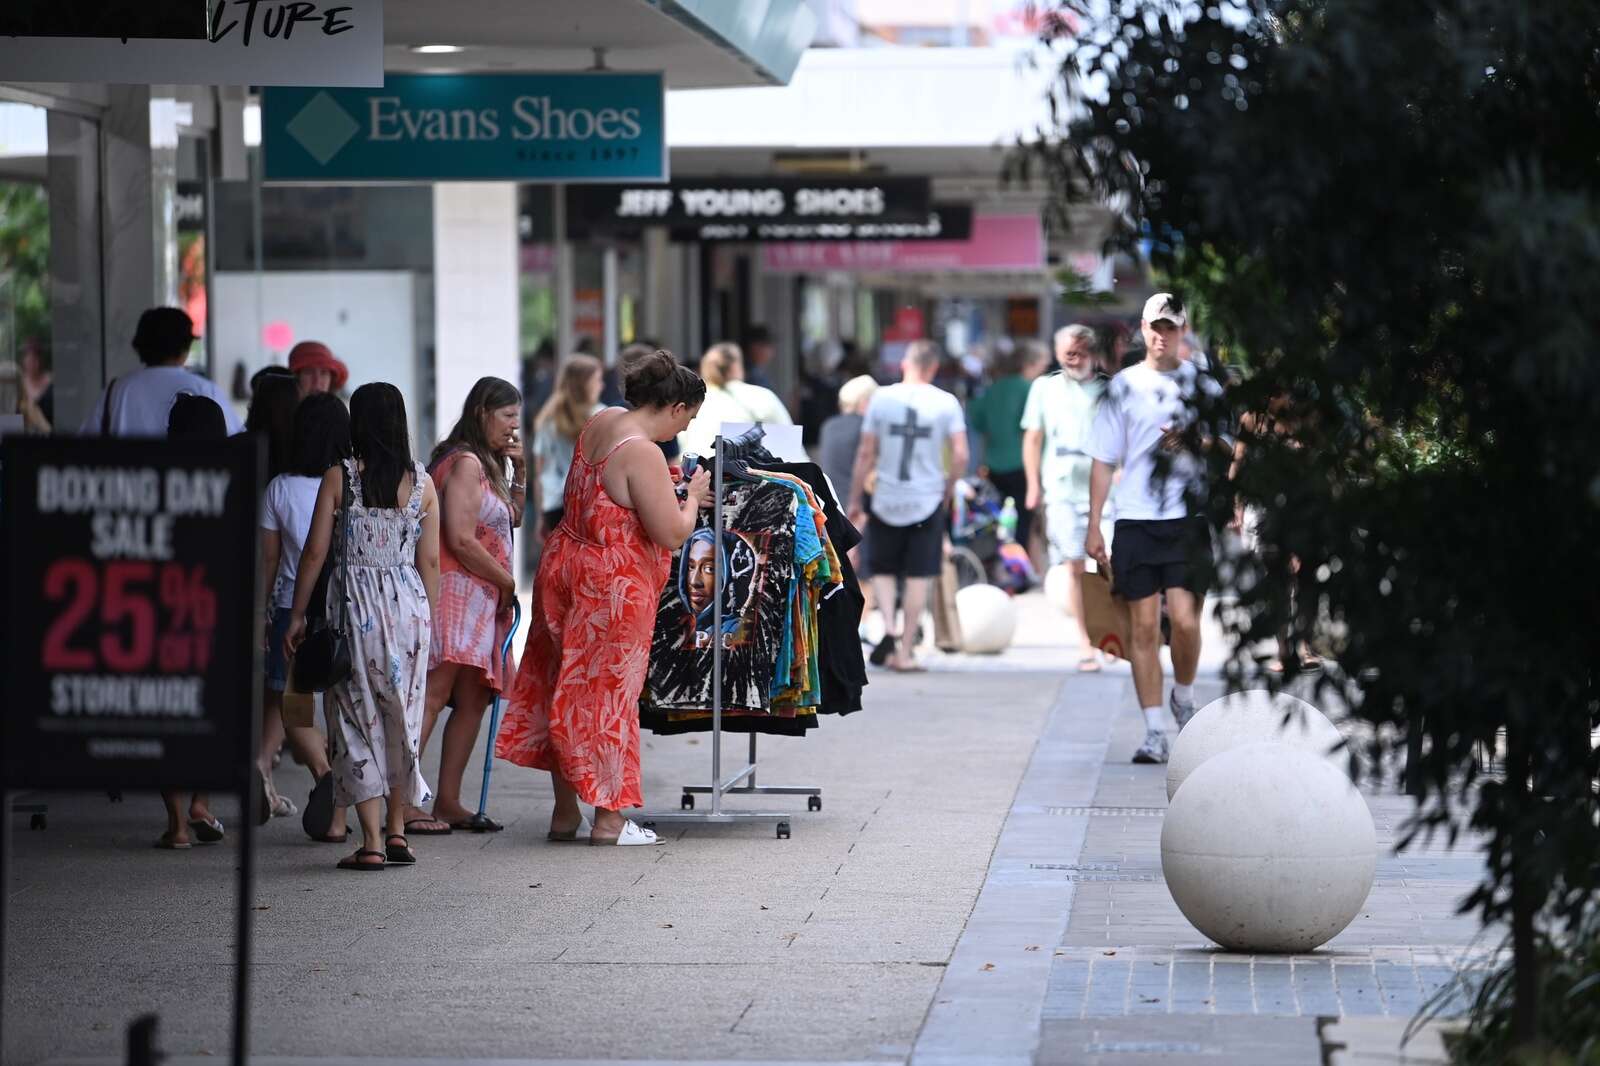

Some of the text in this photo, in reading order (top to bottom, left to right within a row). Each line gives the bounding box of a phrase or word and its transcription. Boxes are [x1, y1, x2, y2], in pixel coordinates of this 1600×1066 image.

[208, 0, 355, 46] LTURE
[367, 96, 641, 141] Evans Shoes
[616, 187, 884, 216] JEFF YOUNG SHOES
[37, 466, 231, 516] BOXING DAY
[91, 512, 175, 559] SALE
[51, 674, 204, 716] STOREWIDE
